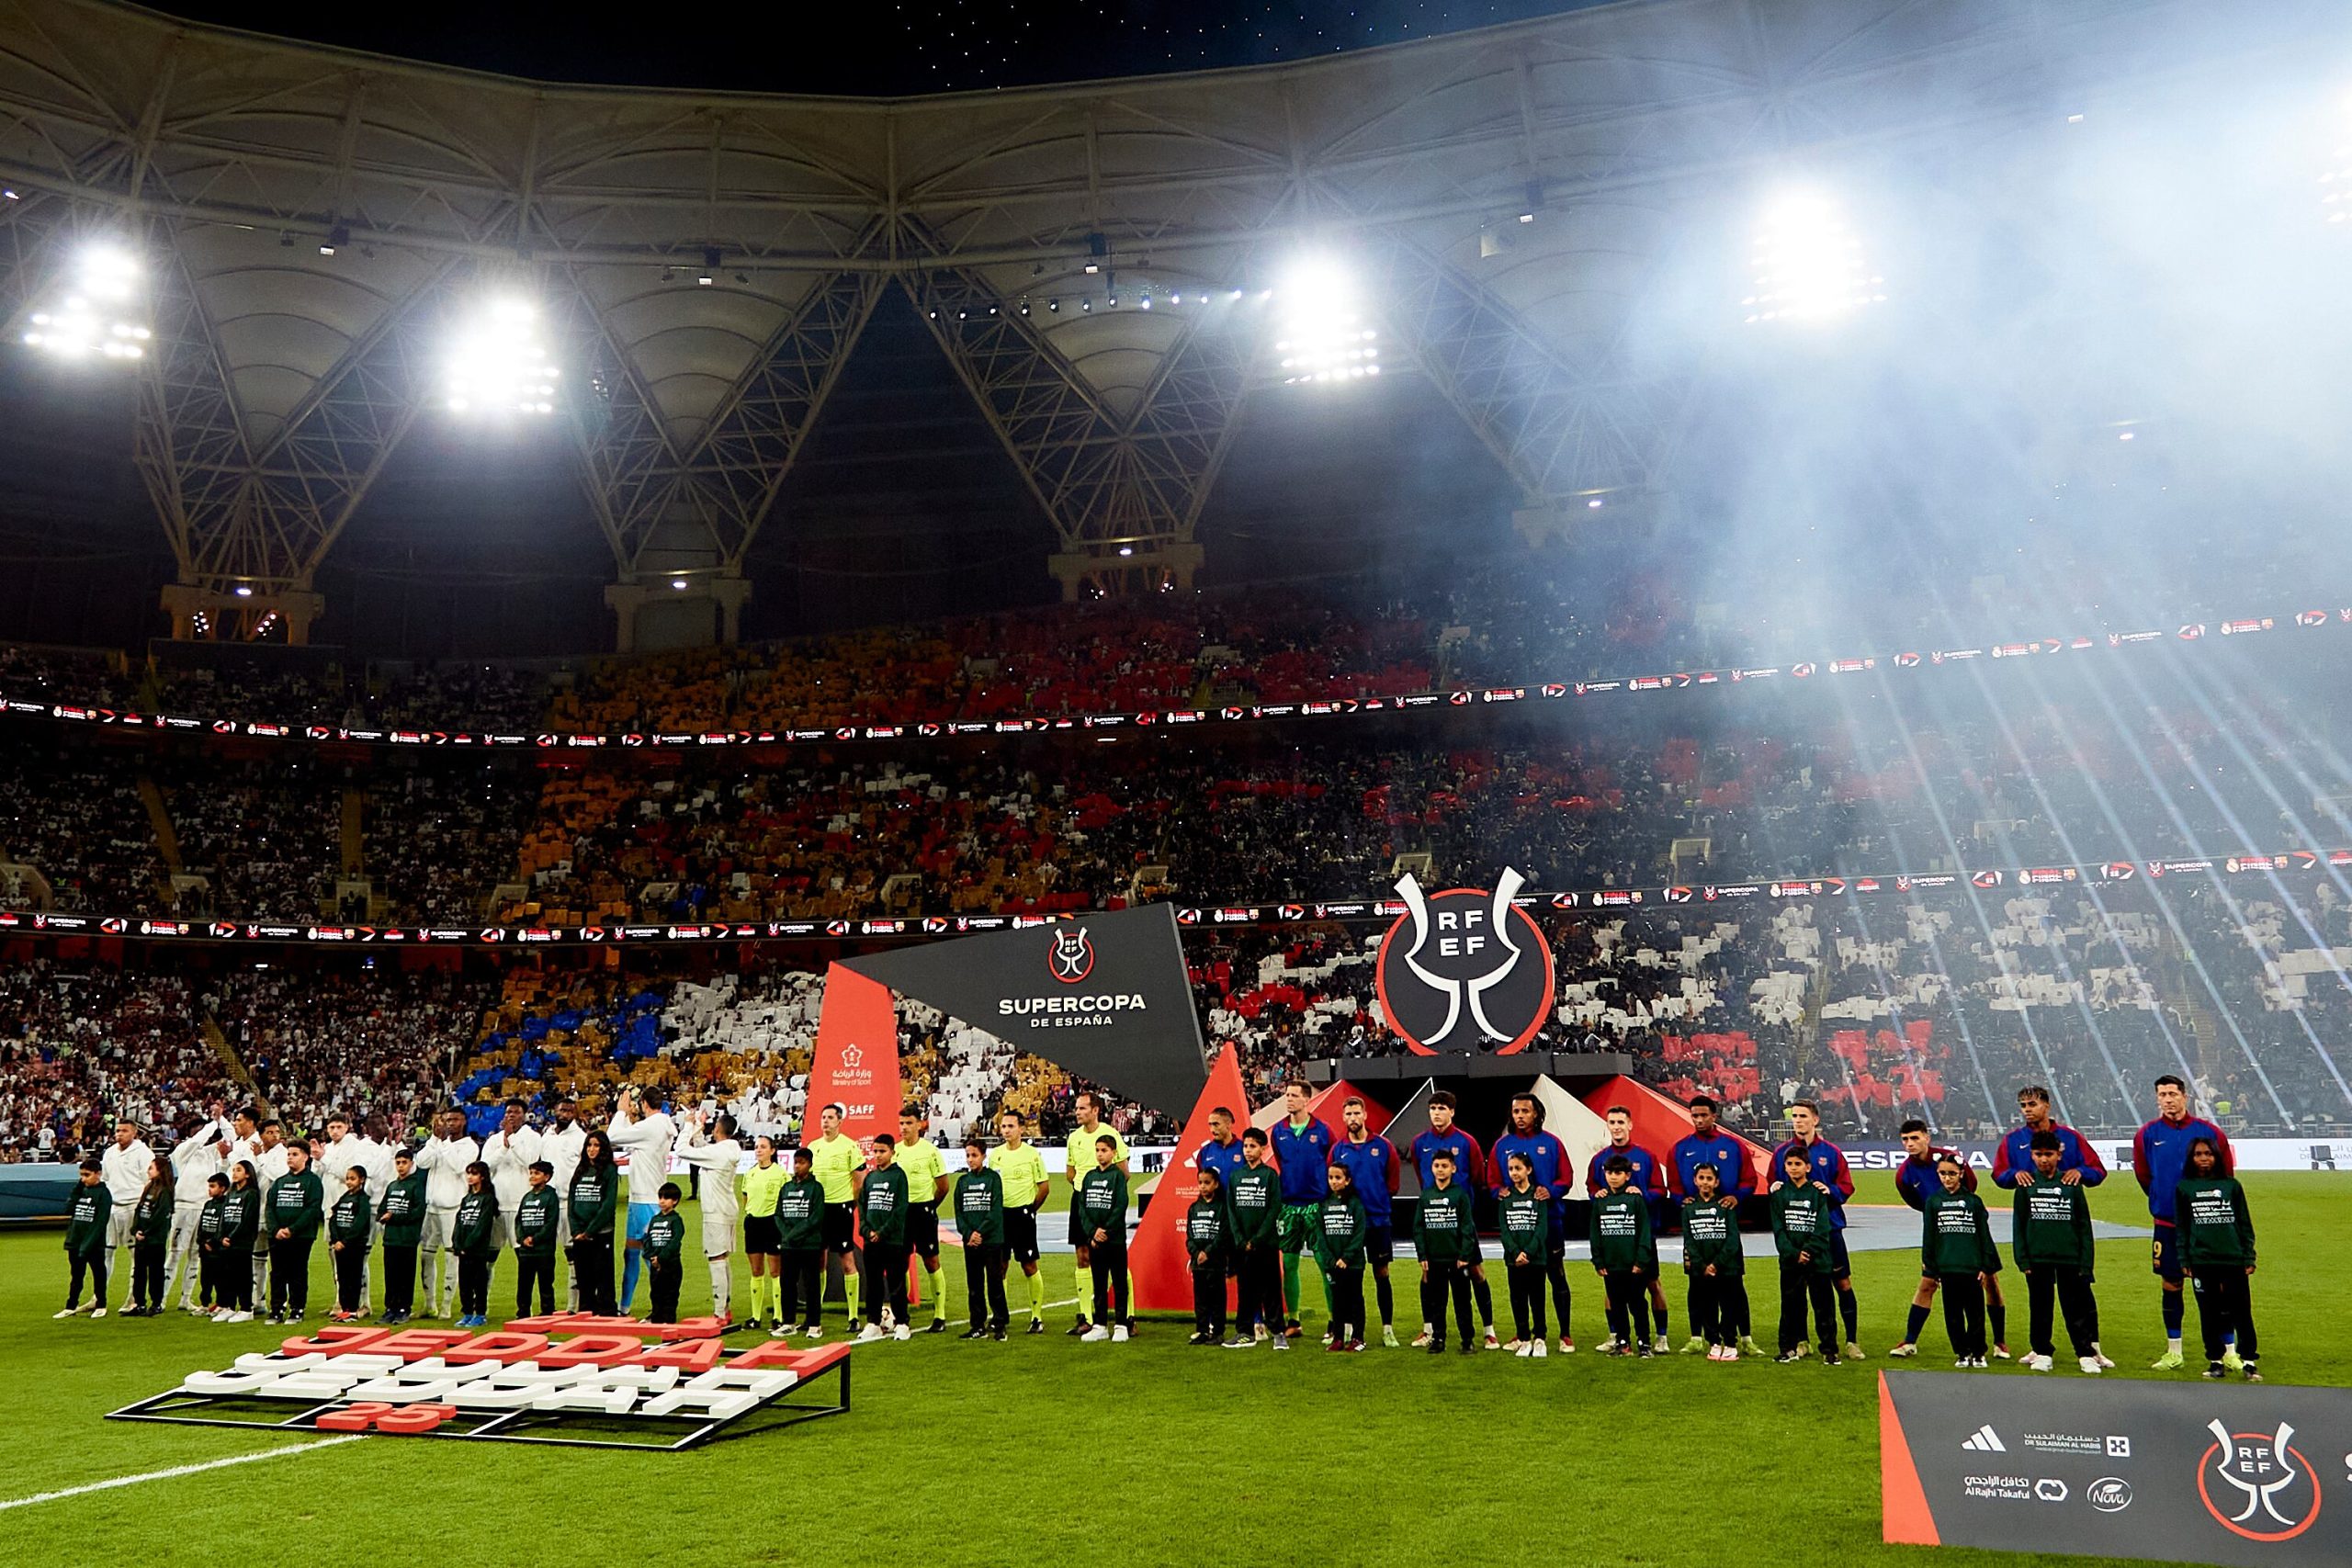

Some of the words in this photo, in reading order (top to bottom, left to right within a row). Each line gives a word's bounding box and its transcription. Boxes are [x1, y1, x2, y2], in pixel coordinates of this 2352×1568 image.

[1439, 909, 1484, 931] RF
[1440, 936, 1485, 956] EF
[999, 994, 1146, 1015] SUPERCOPA
[1030, 1018, 1049, 1028] DE
[1055, 1014, 1113, 1027] ESPAÑA
[832, 1069, 854, 1079] الرياضة
[854, 1069, 872, 1078] وزارة
[848, 1104, 875, 1115] SAFF
[1841, 1145, 1993, 1169] ESPA
[2154, 1241, 2162, 1258] 9
[281, 1325, 851, 1379] JEDDAH
[316, 1402, 457, 1433] 25
[2238, 1447, 2268, 1459] RF
[2240, 1461, 2271, 1473] EF
[1964, 1476, 2000, 1485] الراجحي
[2000, 1478, 2029, 1487] تكافل
[1974, 1489, 1996, 1499] Rajhi
[1998, 1489, 2030, 1499] Takaful
[2093, 1489, 2124, 1504] Nova
